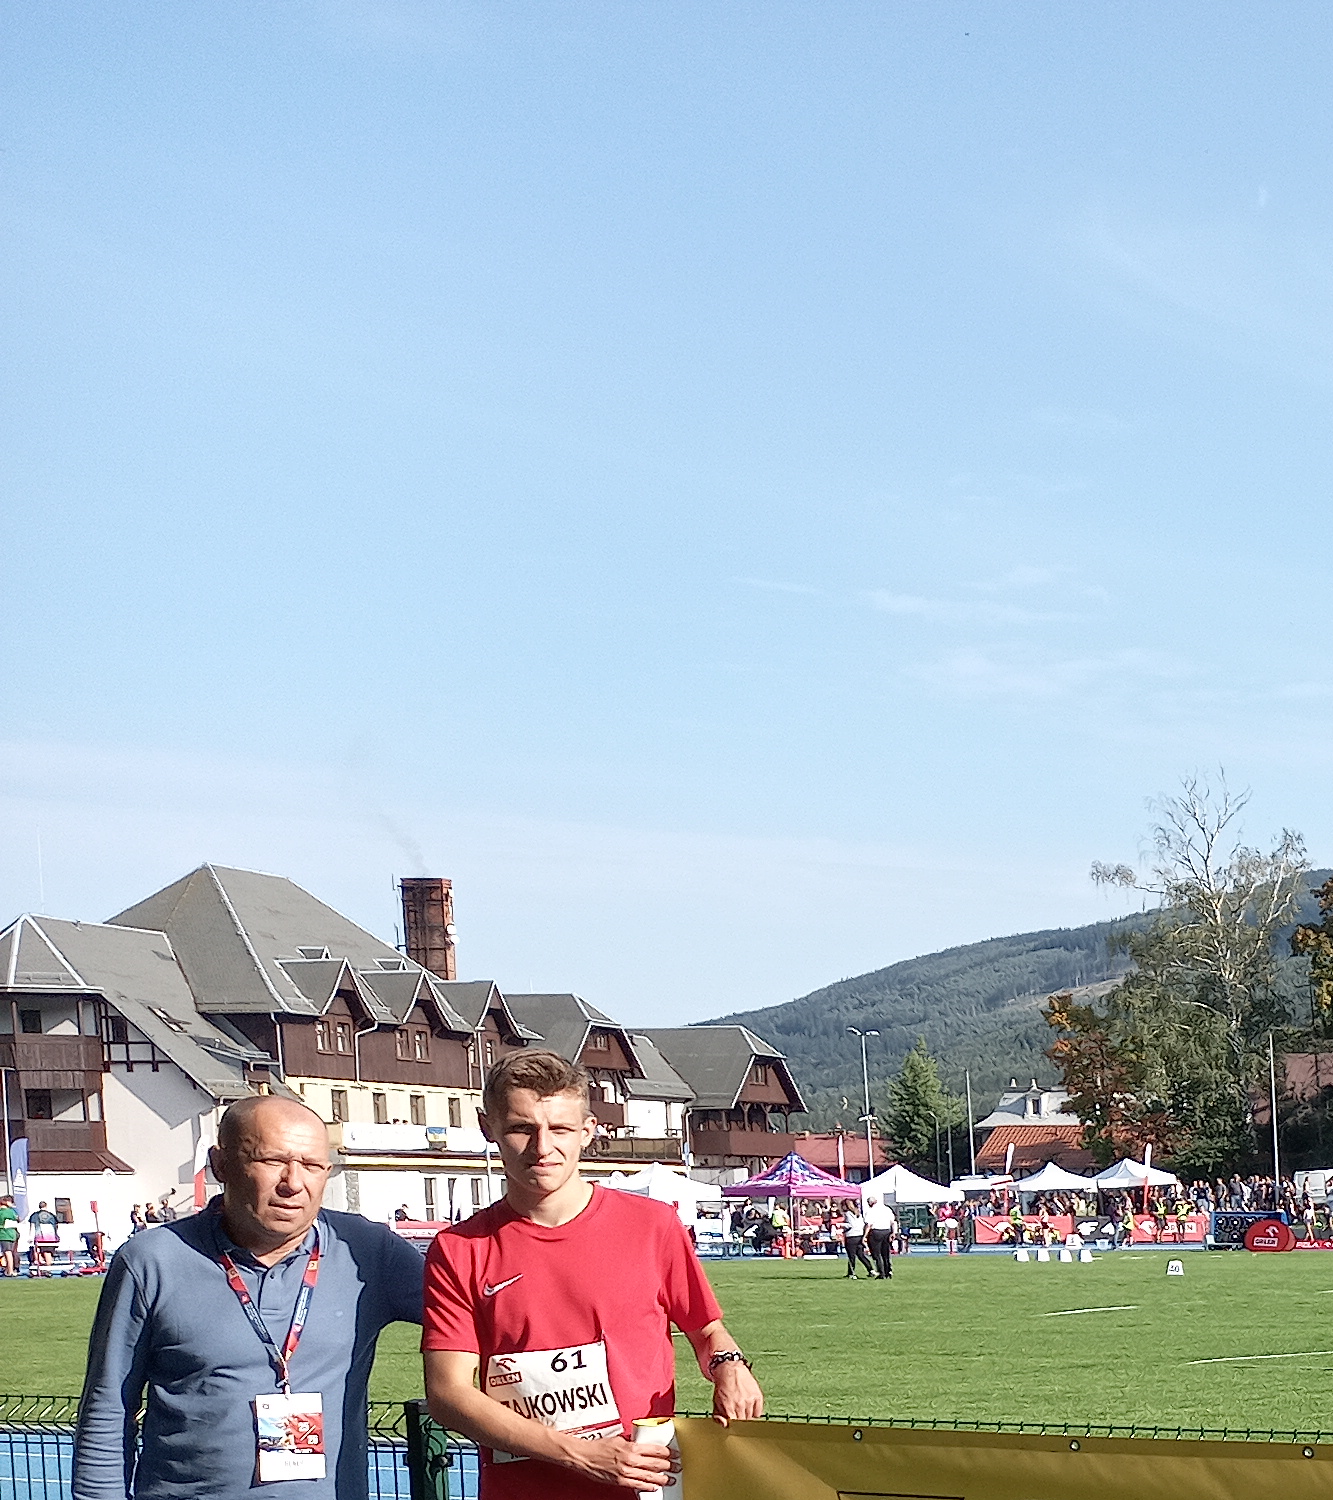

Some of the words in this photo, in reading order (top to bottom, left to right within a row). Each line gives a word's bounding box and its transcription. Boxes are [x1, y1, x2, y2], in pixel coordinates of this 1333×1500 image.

[550, 1349, 588, 1373] 61
[489, 1372, 521, 1387] ORLEN
[500, 1383, 609, 1420] AJKOWSKI
